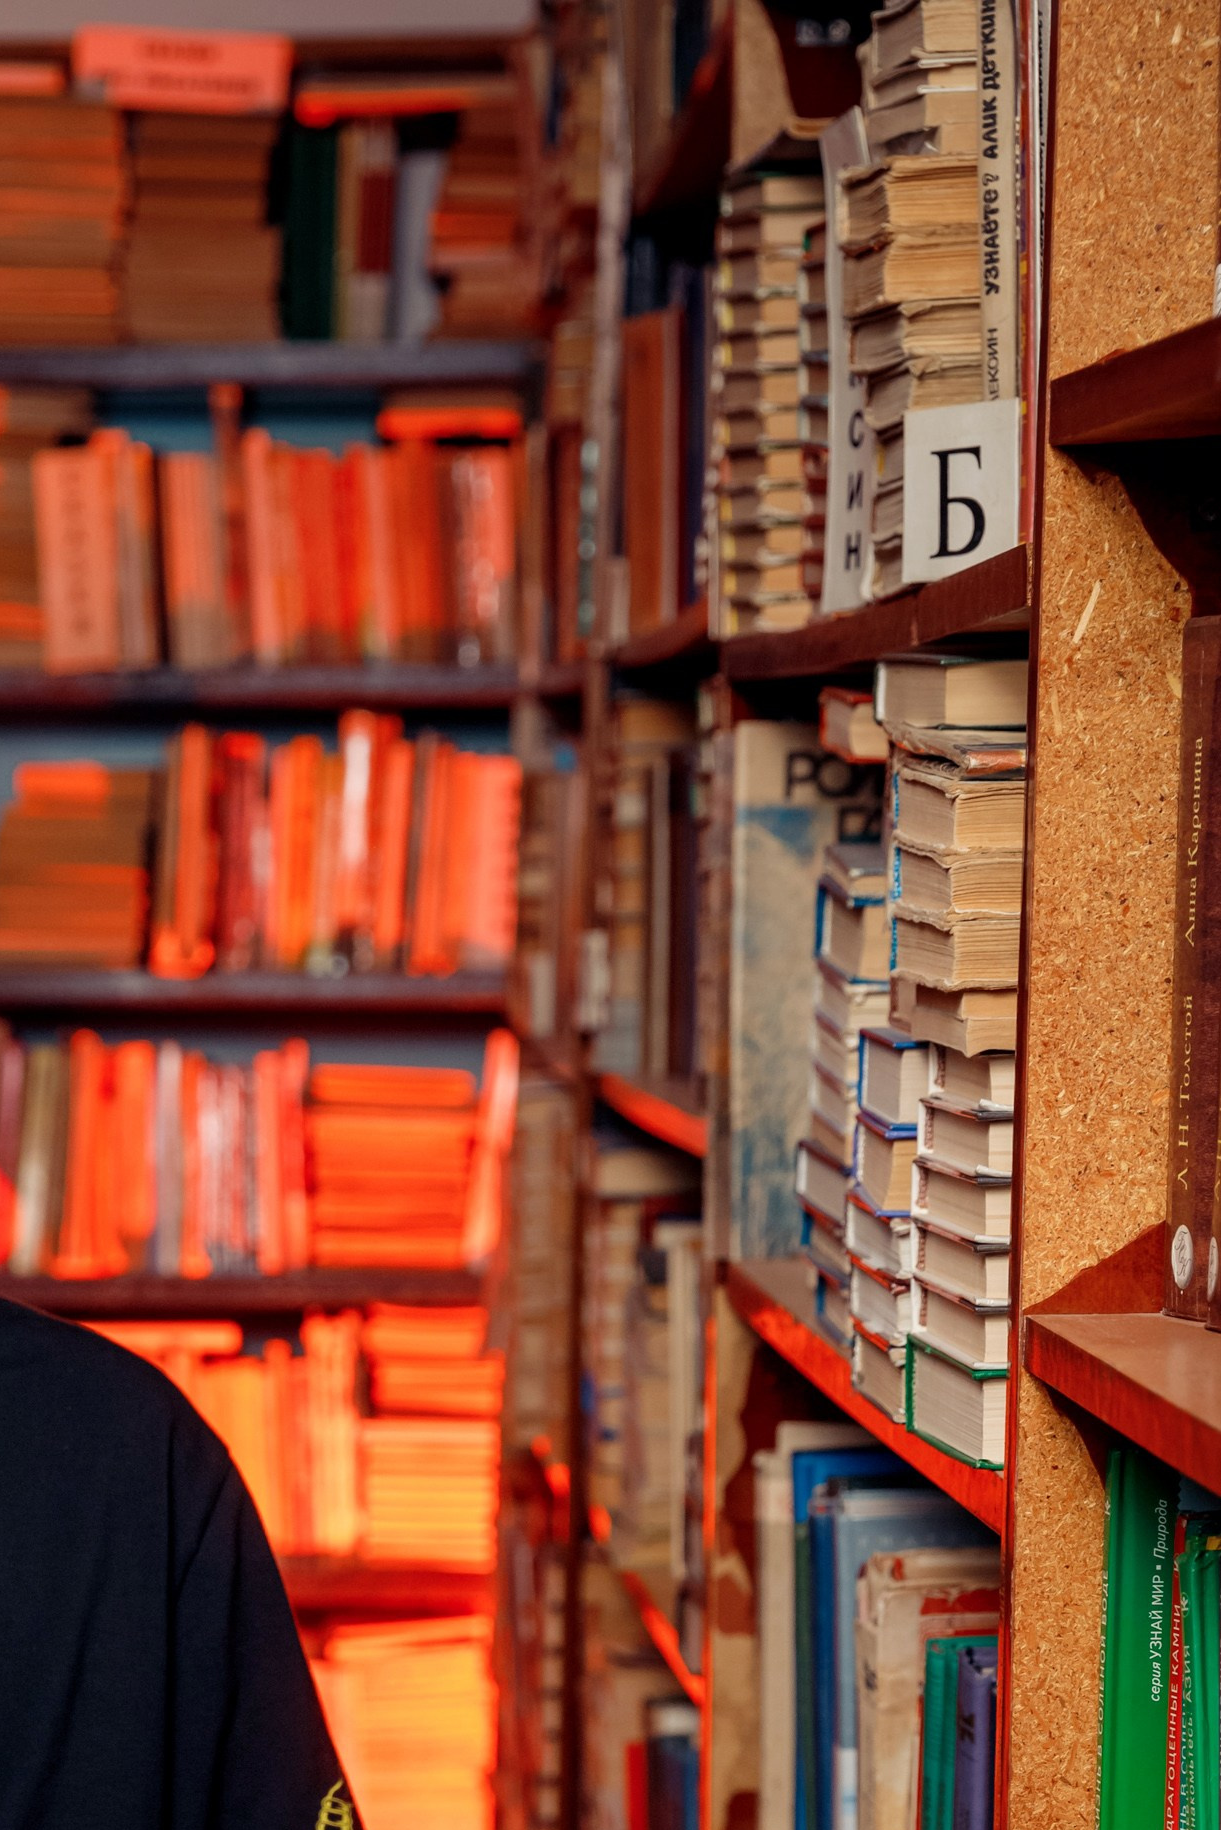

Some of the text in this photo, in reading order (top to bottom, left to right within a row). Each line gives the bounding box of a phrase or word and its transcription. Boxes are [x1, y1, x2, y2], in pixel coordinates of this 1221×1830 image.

[929, 446, 986, 560] Б
[1187, 736, 1204, 867] Каренина
[1184, 876, 1198, 948] Анна
[1179, 995, 1193, 1108] Толстой
[1148, 1499, 1169, 1702] серия УЗНАЙ МИР Природа
[1171, 1604, 1181, 1675] КАМНИ
